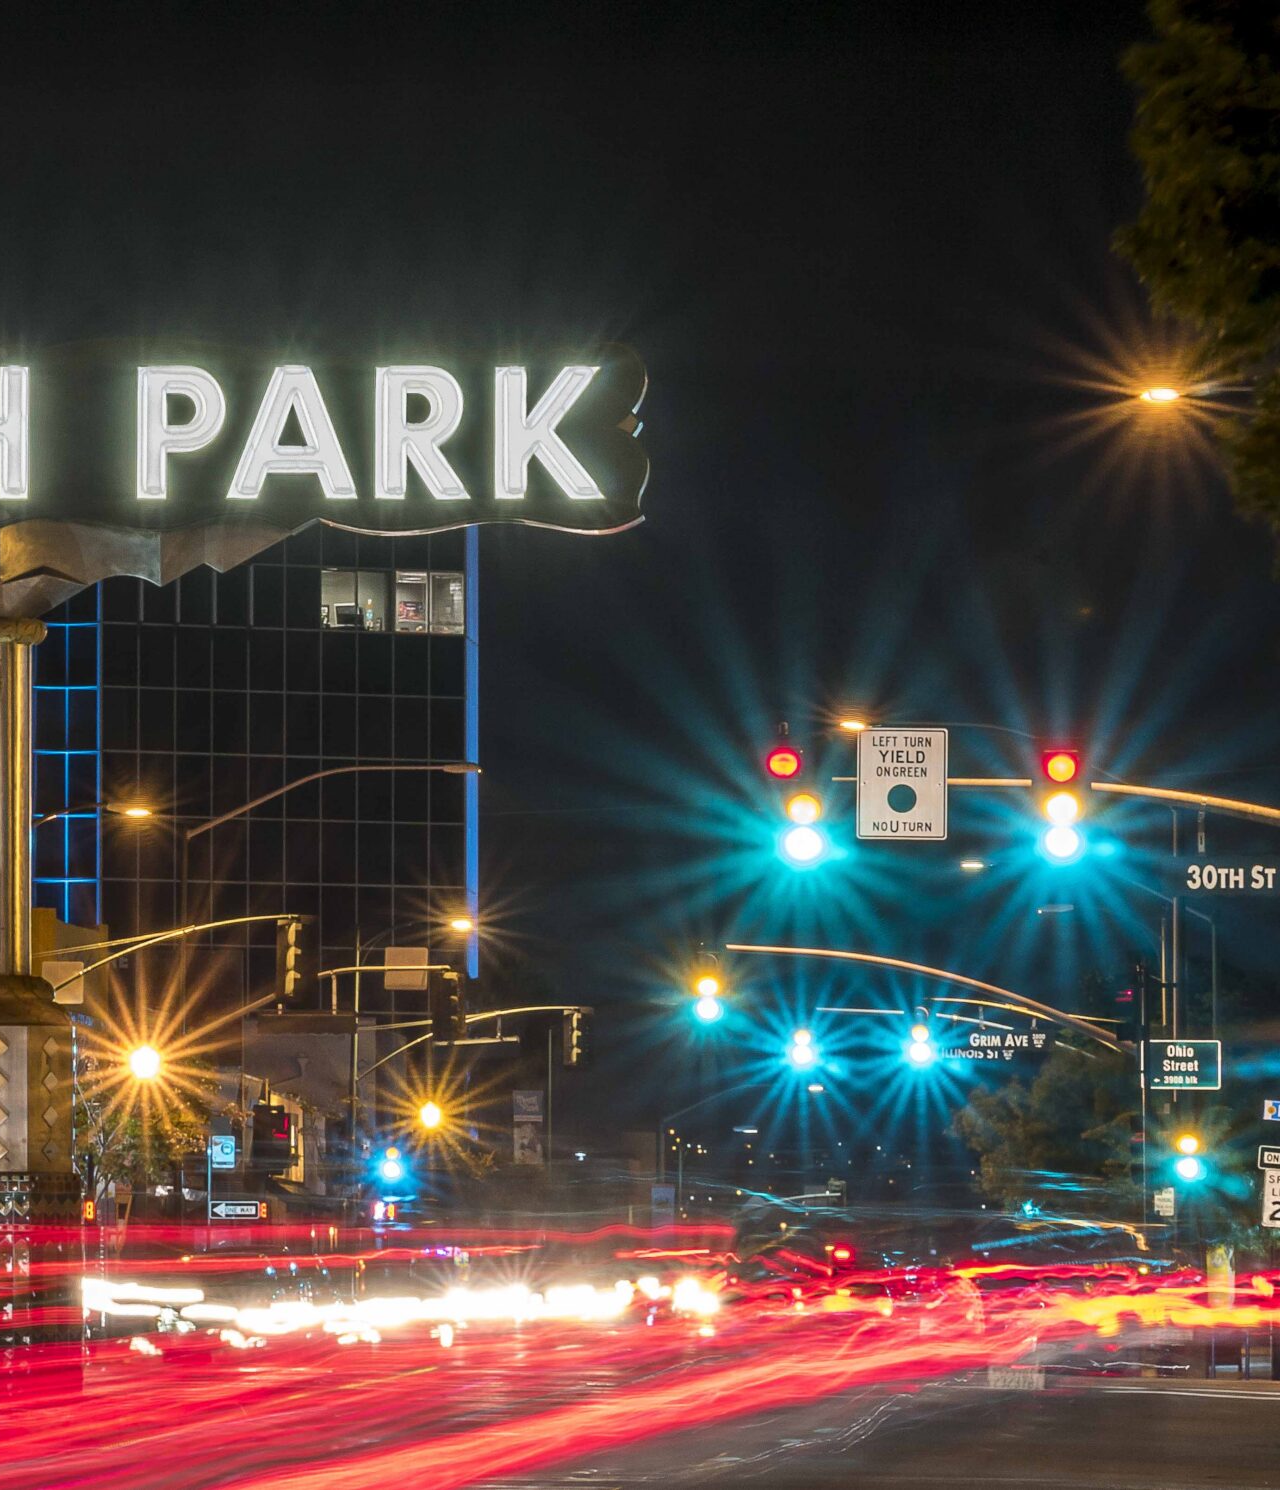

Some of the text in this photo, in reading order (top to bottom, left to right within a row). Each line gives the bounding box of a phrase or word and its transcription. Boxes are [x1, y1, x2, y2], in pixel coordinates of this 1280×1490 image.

[136, 365, 606, 500] PARK
[872, 736, 932, 748] LEFT TURN
[879, 750, 926, 764] YIELD
[876, 766, 928, 778] ON GREEN
[872, 820, 932, 833] NO U TURN
[1186, 864, 1277, 890] 30TH ST
[969, 1033, 1028, 1047] GRIM AVE
[1166, 1045, 1194, 1058] Ohio
[1162, 1059, 1199, 1072] Street
[1266, 1153, 1280, 1163] ON
[1269, 1201, 1280, 1221] 2
